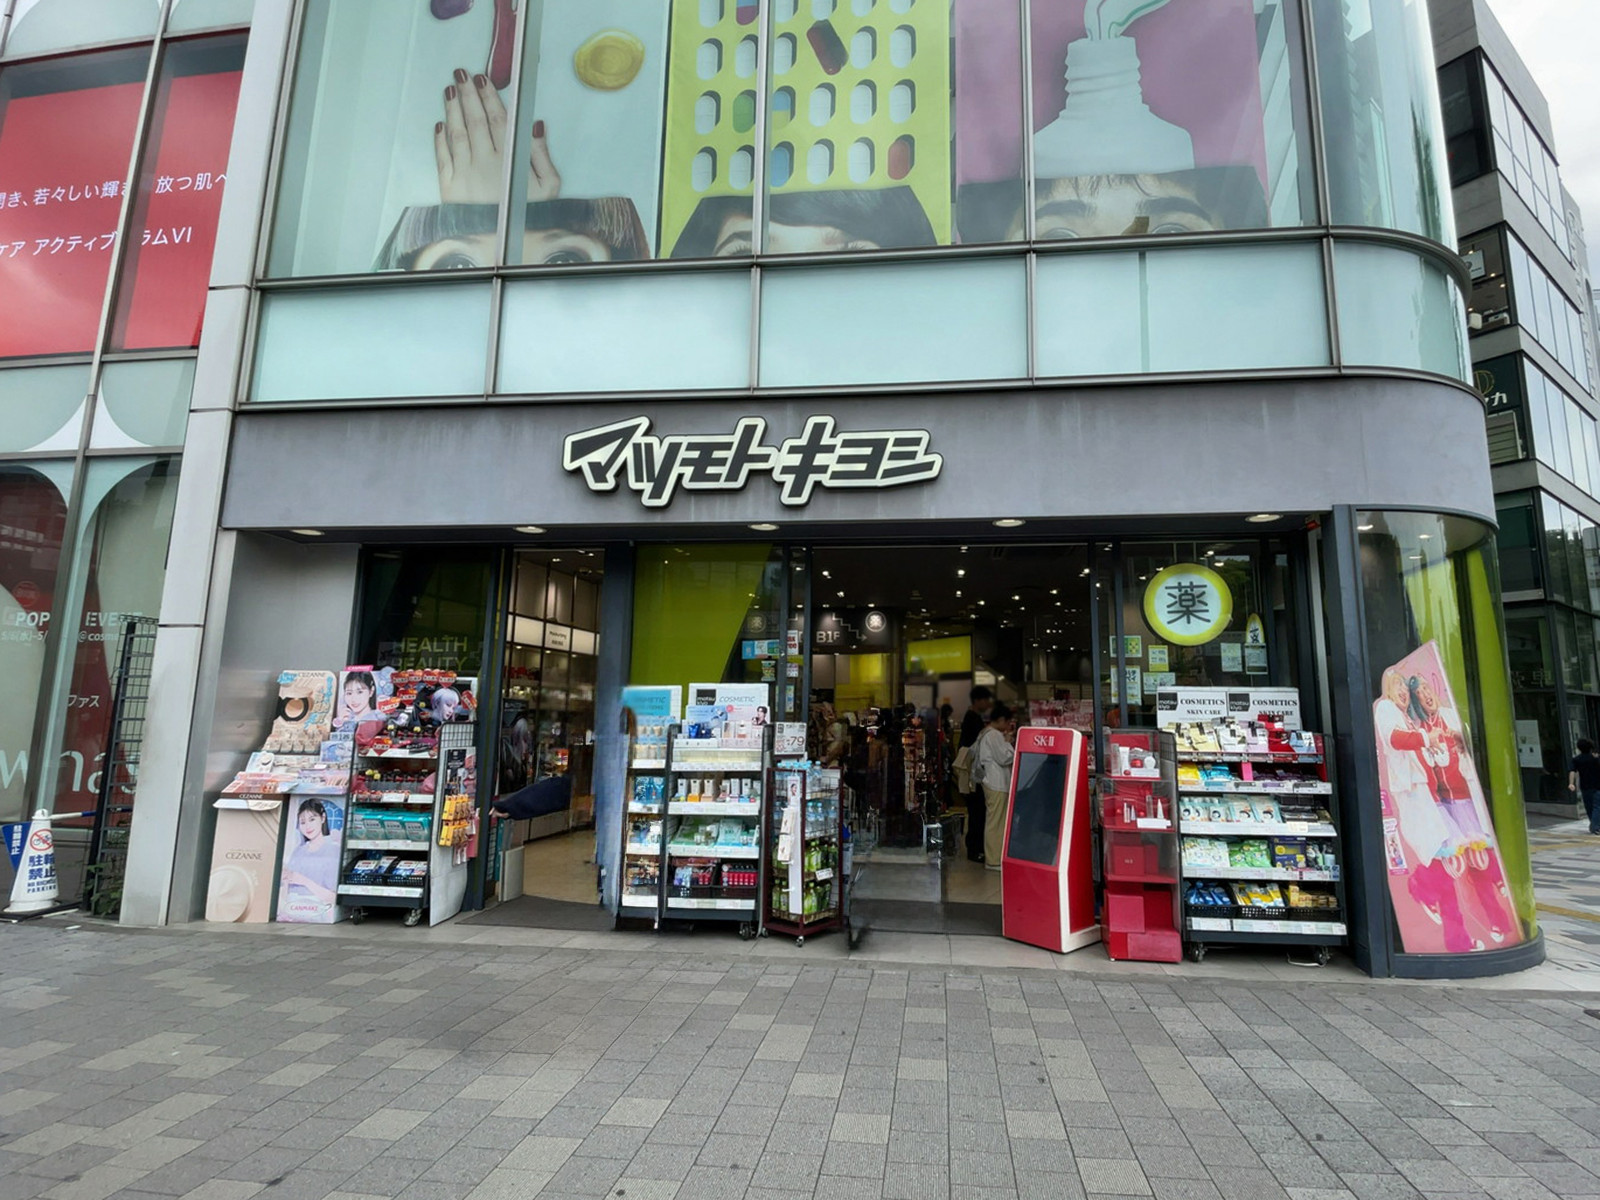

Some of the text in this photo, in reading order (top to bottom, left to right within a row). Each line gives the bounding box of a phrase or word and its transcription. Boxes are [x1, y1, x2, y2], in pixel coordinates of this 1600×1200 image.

[564, 416, 943, 506] マツモトキヨシ
[1164, 581, 1211, 625] 薬
[15, 611, 51, 627] POP
[815, 630, 841, 643] B1F
[392, 636, 468, 653] HEALTH
[718, 695, 756, 703] COSMETIC
[1180, 698, 1225, 706] COSMETICS
[225, 851, 264, 861] CEZANNE
[28, 866, 56, 881] 禁止
